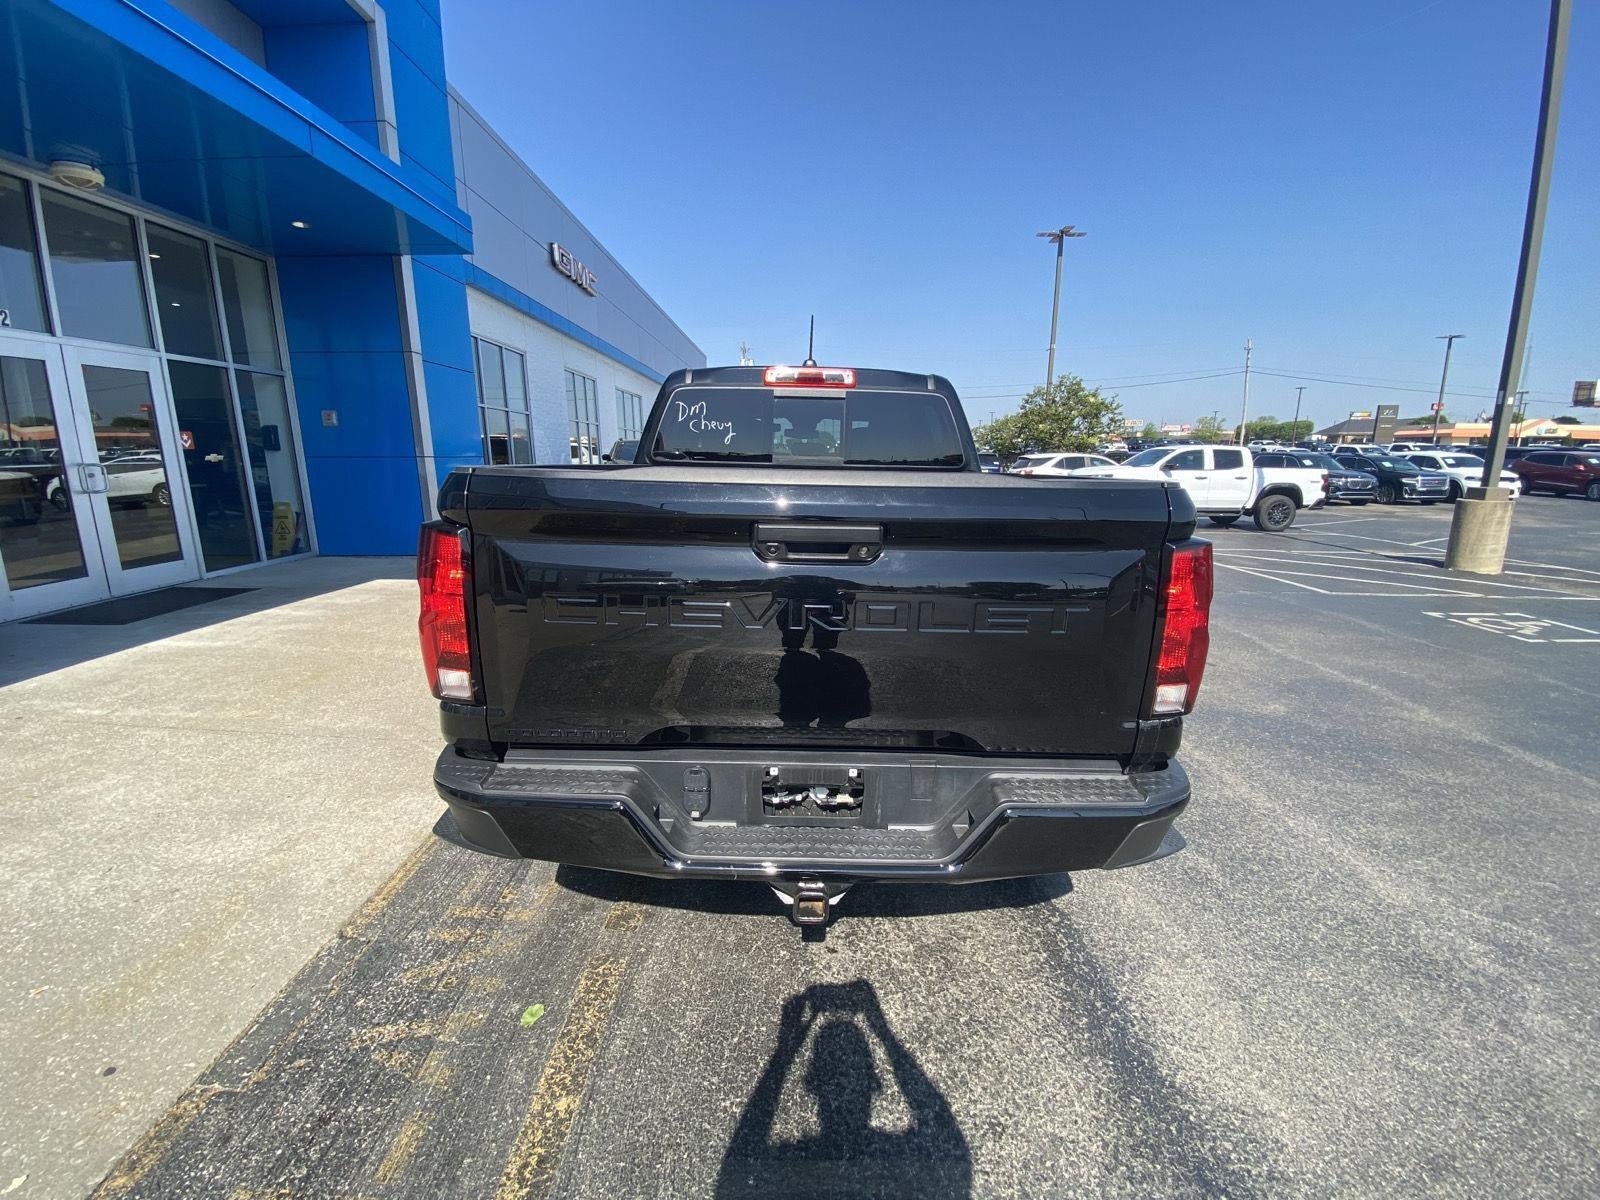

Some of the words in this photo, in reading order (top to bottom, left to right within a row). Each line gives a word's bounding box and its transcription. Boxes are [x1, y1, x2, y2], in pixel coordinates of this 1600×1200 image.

[550, 242, 599, 297] GMC
[689, 415, 736, 444] Chevy
[542, 592, 1091, 635] CHEVROLET
